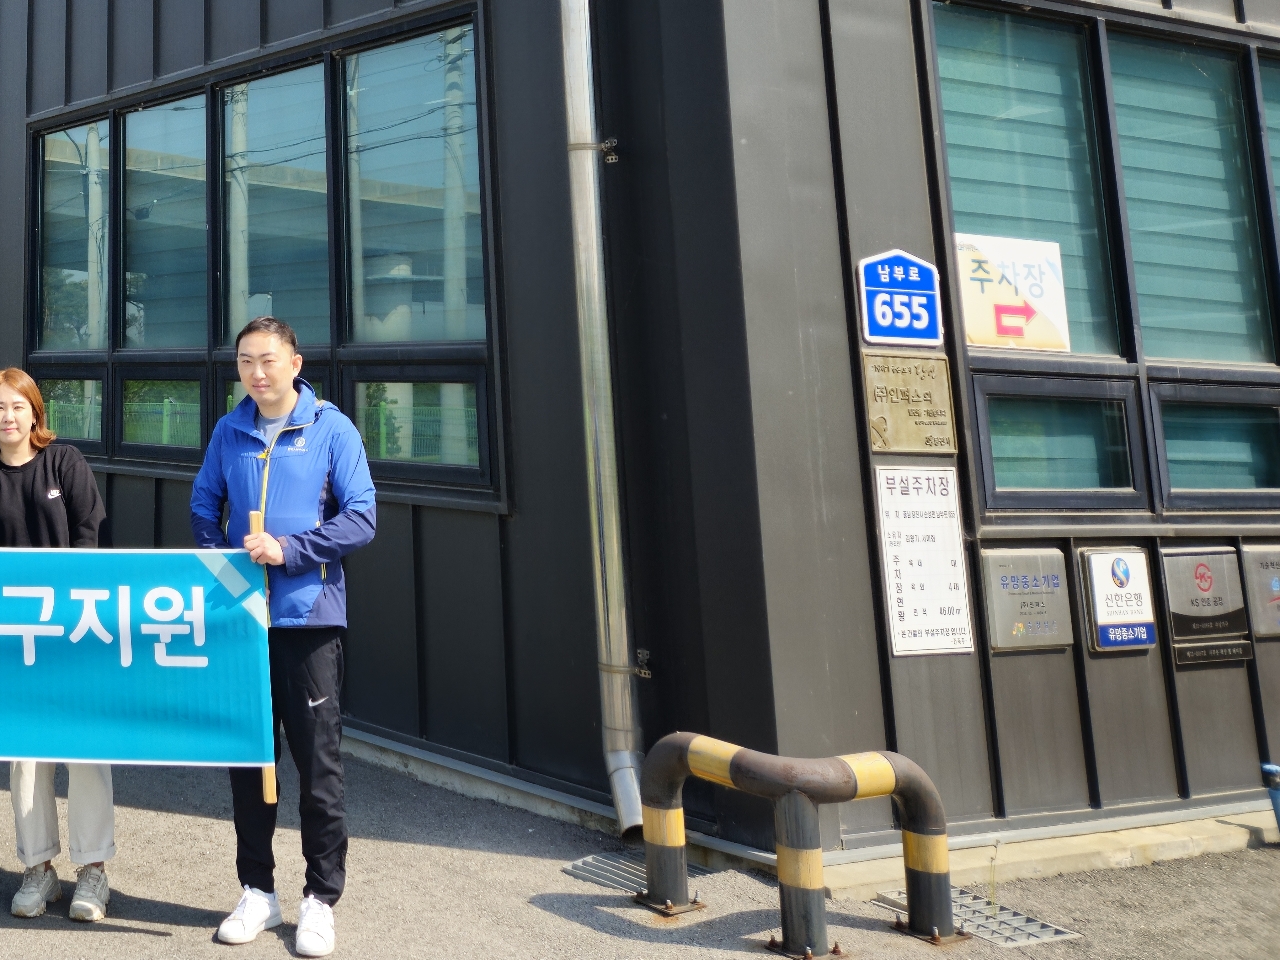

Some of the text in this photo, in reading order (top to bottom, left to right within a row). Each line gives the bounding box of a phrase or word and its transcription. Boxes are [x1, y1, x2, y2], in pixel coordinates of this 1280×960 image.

[877, 264, 921, 282] 남부로
[970, 258, 1046, 299] 주차장
[874, 292, 929, 329] 655
[885, 475, 950, 497] 부설주차장
[1000, 574, 1060, 590] 유망중소기업
[1104, 592, 1143, 608] 신한은행
[1108, 626, 1148, 641] 유망중소기업
